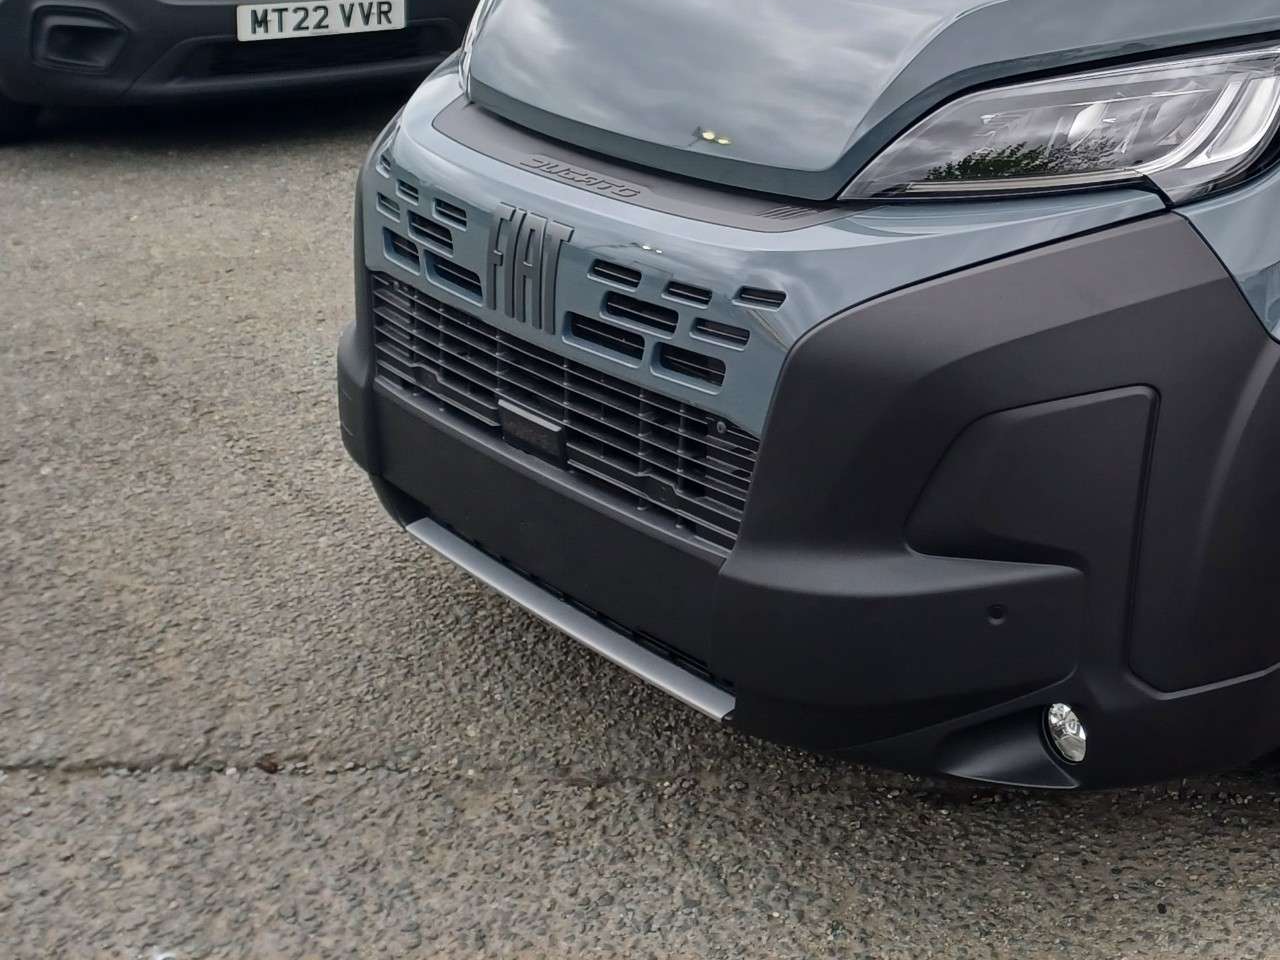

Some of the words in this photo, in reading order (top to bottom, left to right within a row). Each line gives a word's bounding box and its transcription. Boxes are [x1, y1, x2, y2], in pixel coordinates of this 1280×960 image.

[250, 4, 329, 35] MT22
[339, 0, 393, 28] VVR
[519, 158, 642, 198] DUCATO
[486, 201, 575, 336] FIAT
